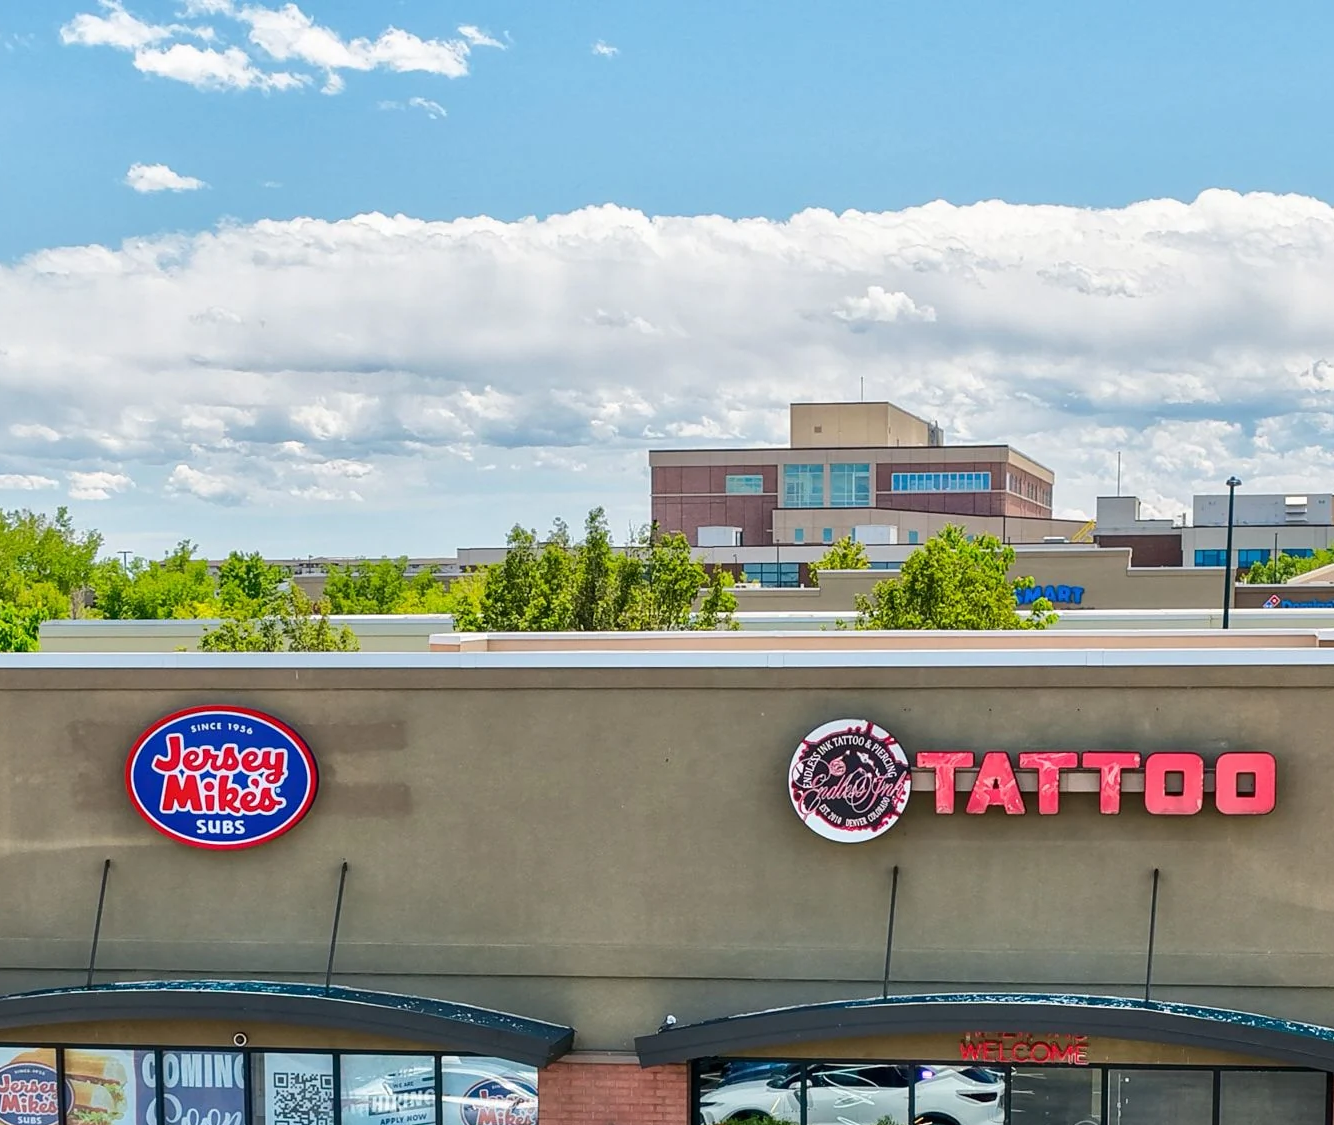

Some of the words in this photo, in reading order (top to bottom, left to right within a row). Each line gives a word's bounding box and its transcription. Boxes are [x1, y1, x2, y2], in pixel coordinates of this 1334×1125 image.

[190, 722, 222, 733] SINCE
[227, 723, 253, 735] 1956
[152, 735, 286, 784] Jersey
[802, 751, 822, 789] ENDLESS
[817, 741, 834, 757] INK
[832, 735, 865, 748] TATTOO
[864, 739, 872, 750] &
[872, 744, 898, 779] PIERCING
[161, 773, 284, 814] Mike's
[916, 752, 1276, 815] TATTOO
[867, 796, 891, 823] COLORADO
[196, 820, 246, 835] SUBS
[959, 1041, 1089, 1065] WELCOME
[17, 1117, 43, 1125] SUBS
[380, 1116, 404, 1125] APPLY
[407, 1113, 427, 1121] NOW
